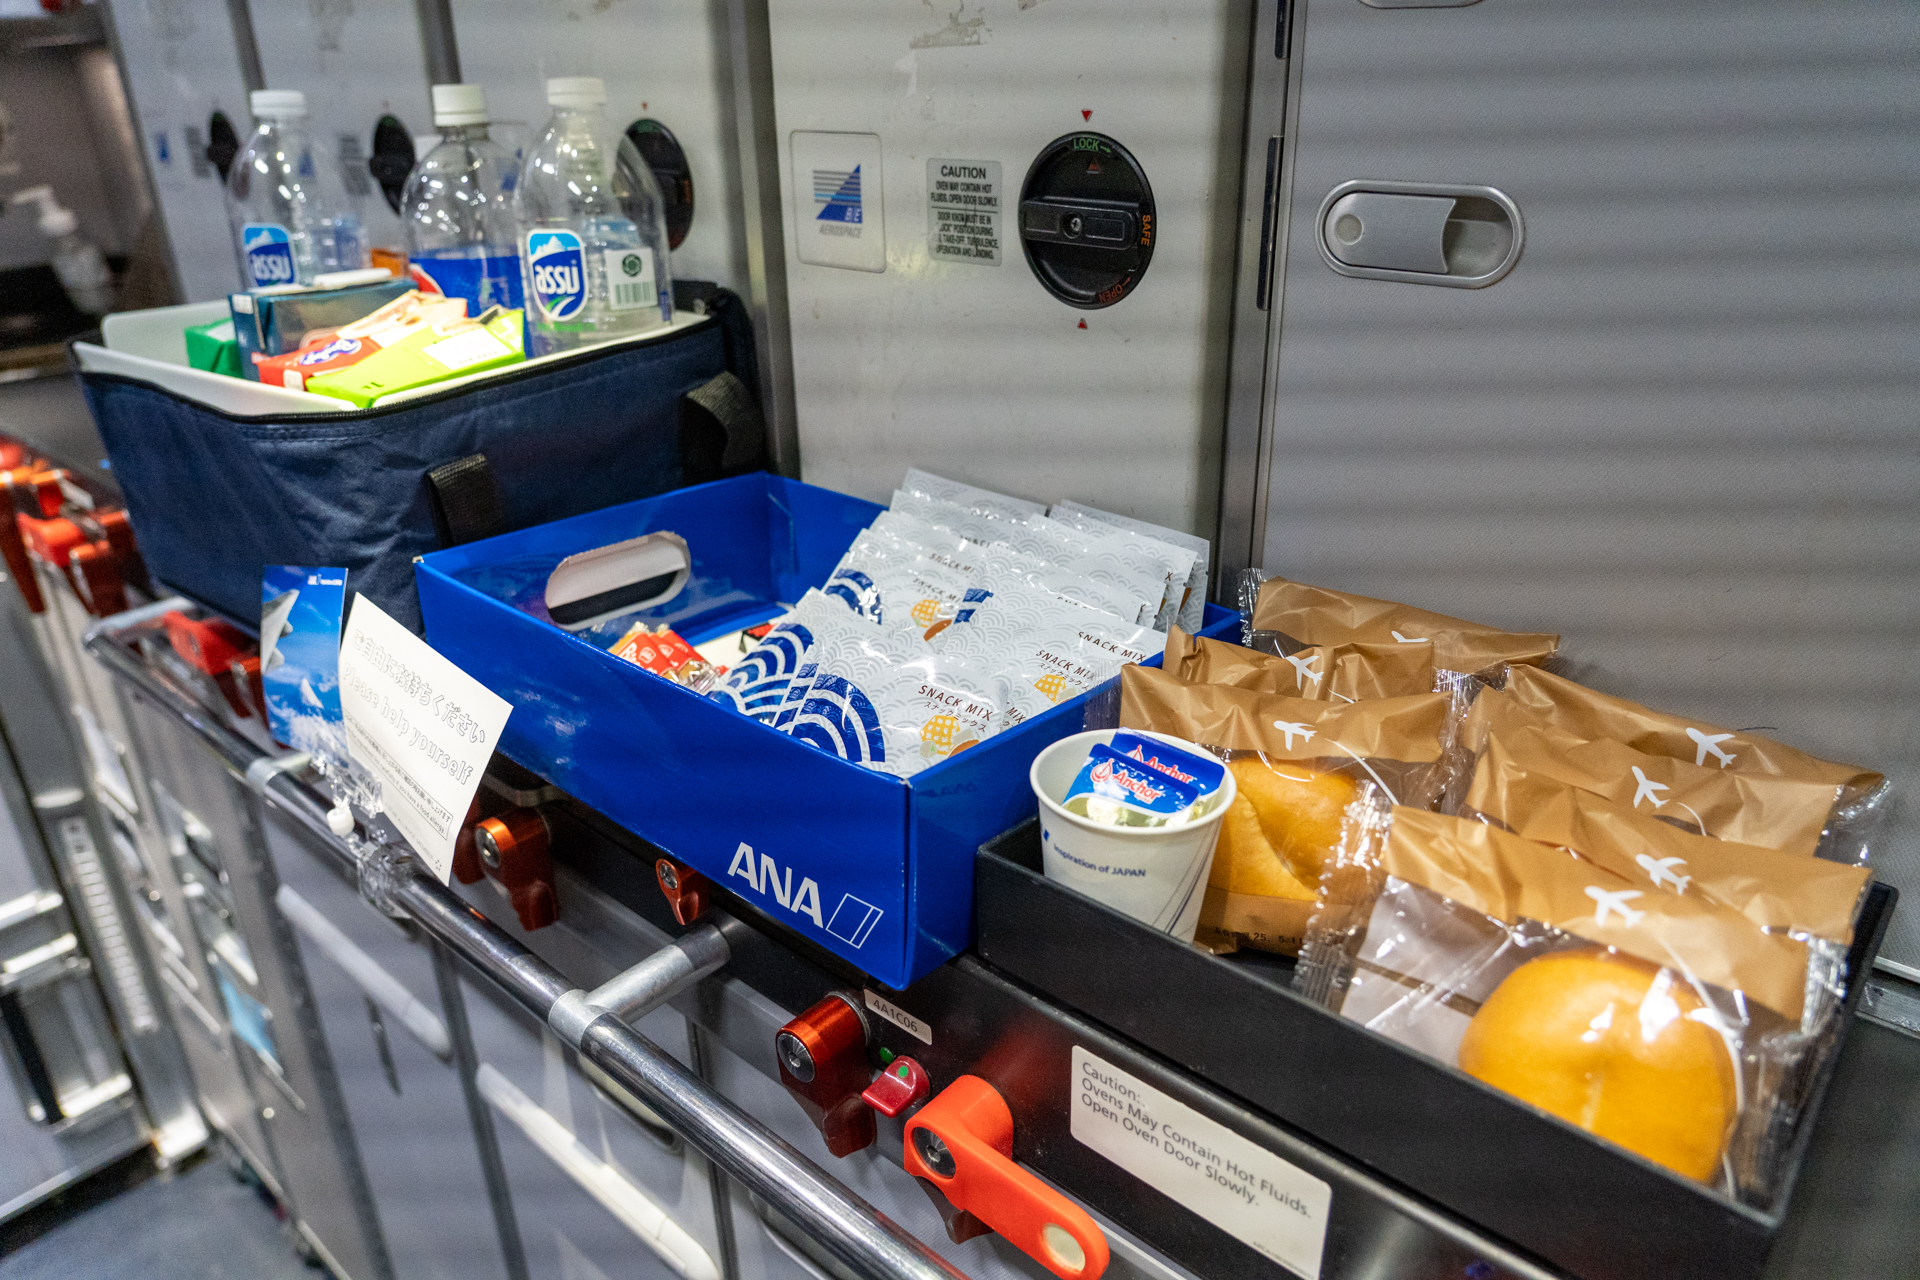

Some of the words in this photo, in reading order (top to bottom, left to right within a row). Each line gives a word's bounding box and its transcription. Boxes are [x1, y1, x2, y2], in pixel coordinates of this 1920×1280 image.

[1073, 138, 1100, 151] LOCK
[941, 165, 986, 179] CAUTION
[948, 193, 962, 204] OPEN
[962, 194, 977, 205] DOOR
[960, 182, 981, 193] CONTAIN
[981, 184, 992, 194] HOT
[979, 214, 986, 225] BE
[1141, 214, 1151, 246] SAFE
[1098, 284, 1123, 303] OPEN
[929, 553, 961, 569] SNACK
[1035, 649, 1074, 671] SNACK
[1078, 631, 1119, 653] SNACK
[1121, 649, 1147, 662] MIX
[352, 629, 486, 743] ご自由にお持ちください
[918, 685, 963, 707] SNACK
[965, 703, 994, 721] MIX
[924, 701, 987, 732] スナックミックス
[1006, 706, 1026, 724] MIX
[342, 662, 380, 709] Please
[380, 696, 410, 736] help
[408, 727, 474, 785] yourself
[1112, 770, 1161, 801] Anchor
[1144, 756, 1195, 785] Anchor
[727, 841, 824, 929] ANA
[1098, 865, 1110, 874] of
[1111, 867, 1146, 877] JAPAN
[873, 999, 918, 1033] 4A1C06
[1082, 1061, 1141, 1105] Caution:
[1081, 1093, 1119, 1123] Open
[1122, 1116, 1159, 1147] Oven
[1164, 1141, 1201, 1171] Door
[1205, 1164, 1259, 1207] Slowly.
[1082, 1077, 1124, 1110] Ovens
[1127, 1103, 1158, 1131] May
[1162, 1124, 1222, 1166] Contain
[1226, 1159, 1255, 1186] Hot
[1260, 1179, 1311, 1219] Fluids.
